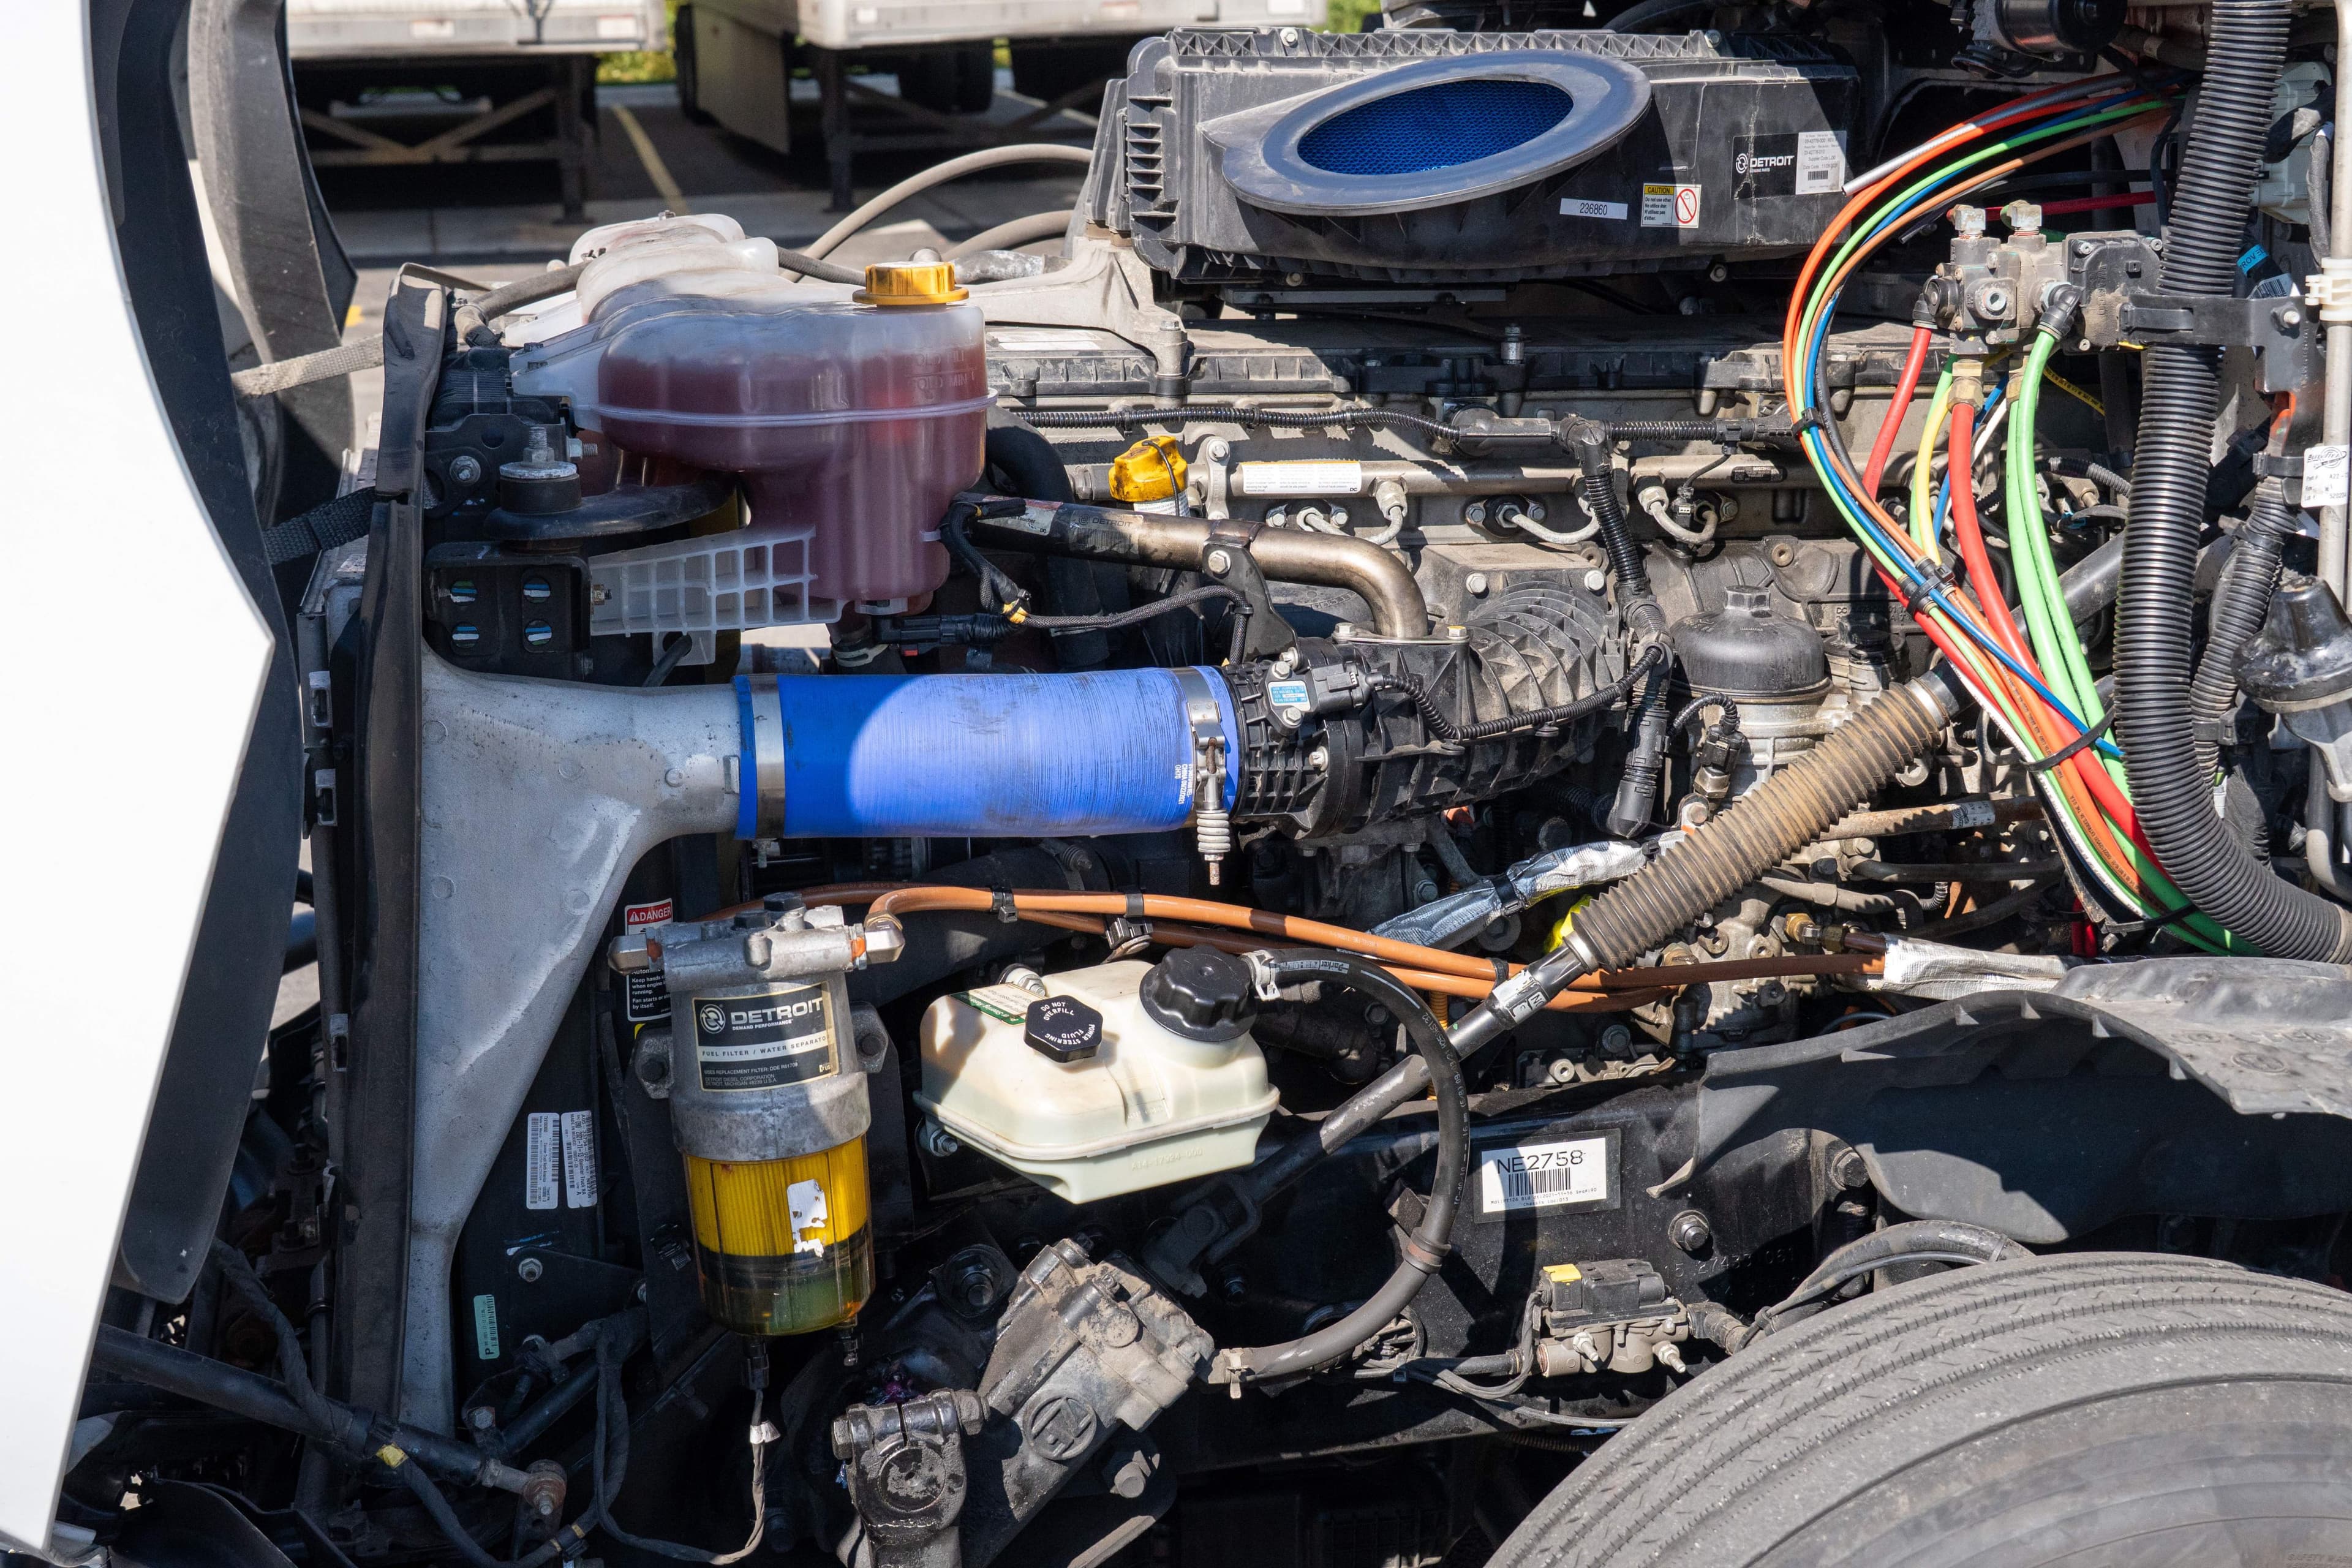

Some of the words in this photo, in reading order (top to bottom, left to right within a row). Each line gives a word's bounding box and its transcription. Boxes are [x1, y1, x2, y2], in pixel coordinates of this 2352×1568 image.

[1749, 156, 1794, 167] DETROIT
[1580, 203, 1608, 215] 236860
[1092, 518, 1134, 527] DETROIT
[639, 907, 671, 922] DANGER
[730, 997, 823, 1025] DETROIT
[1043, 1008, 1074, 1020] OVERFILL
[754, 1019, 793, 1029] PERFORMANCE
[1061, 1029, 1084, 1039] FLUID
[1082, 1024, 1096, 1041] POWER
[1044, 1033, 1081, 1045] STEERING
[760, 1046, 787, 1054] WATER
[1462, 1126, 1469, 1137] 16
[1497, 1150, 1583, 1174] NE2758
[1664, 1263, 1685, 1278] 15
